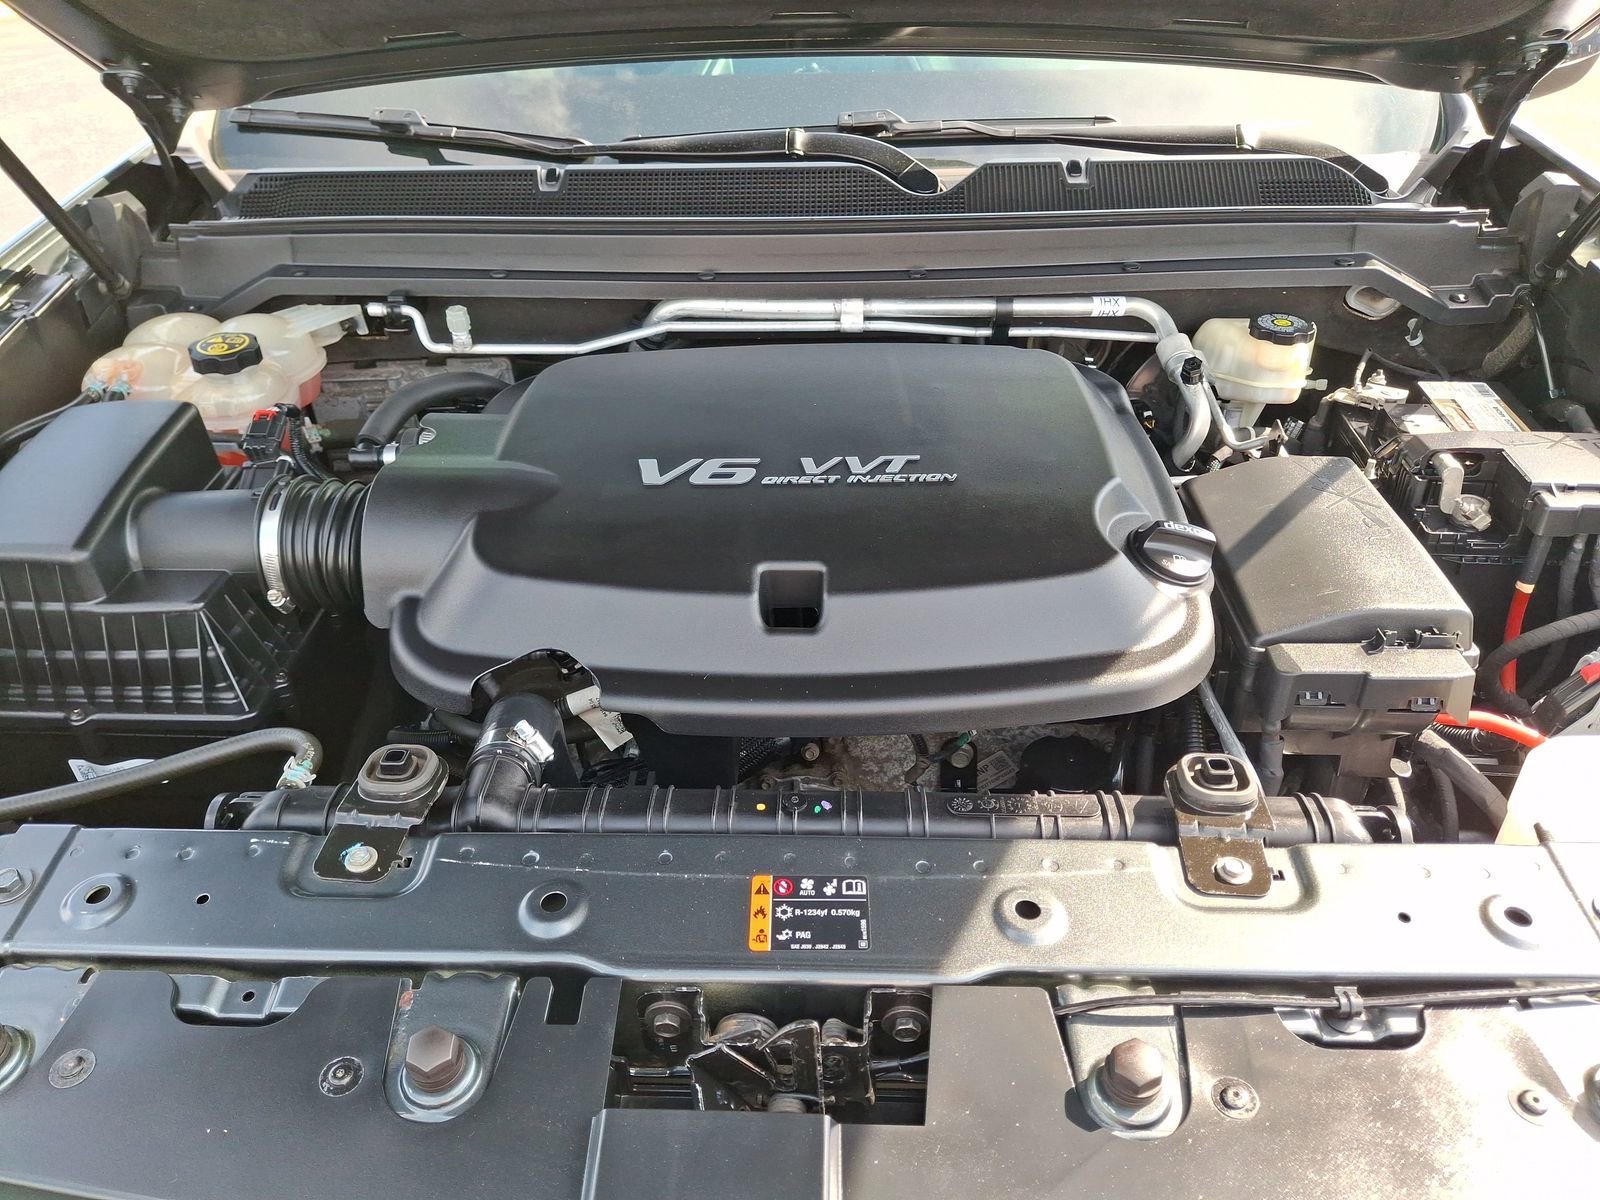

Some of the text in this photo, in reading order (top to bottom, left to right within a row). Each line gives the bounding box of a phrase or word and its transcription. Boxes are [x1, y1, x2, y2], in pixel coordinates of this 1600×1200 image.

[638, 455, 921, 486] V6 VVT
[761, 473, 958, 485] DIRECT INJECTION
[794, 908, 861, 918] R-1234yf 0.570kg
[795, 931, 811, 939] PAG
